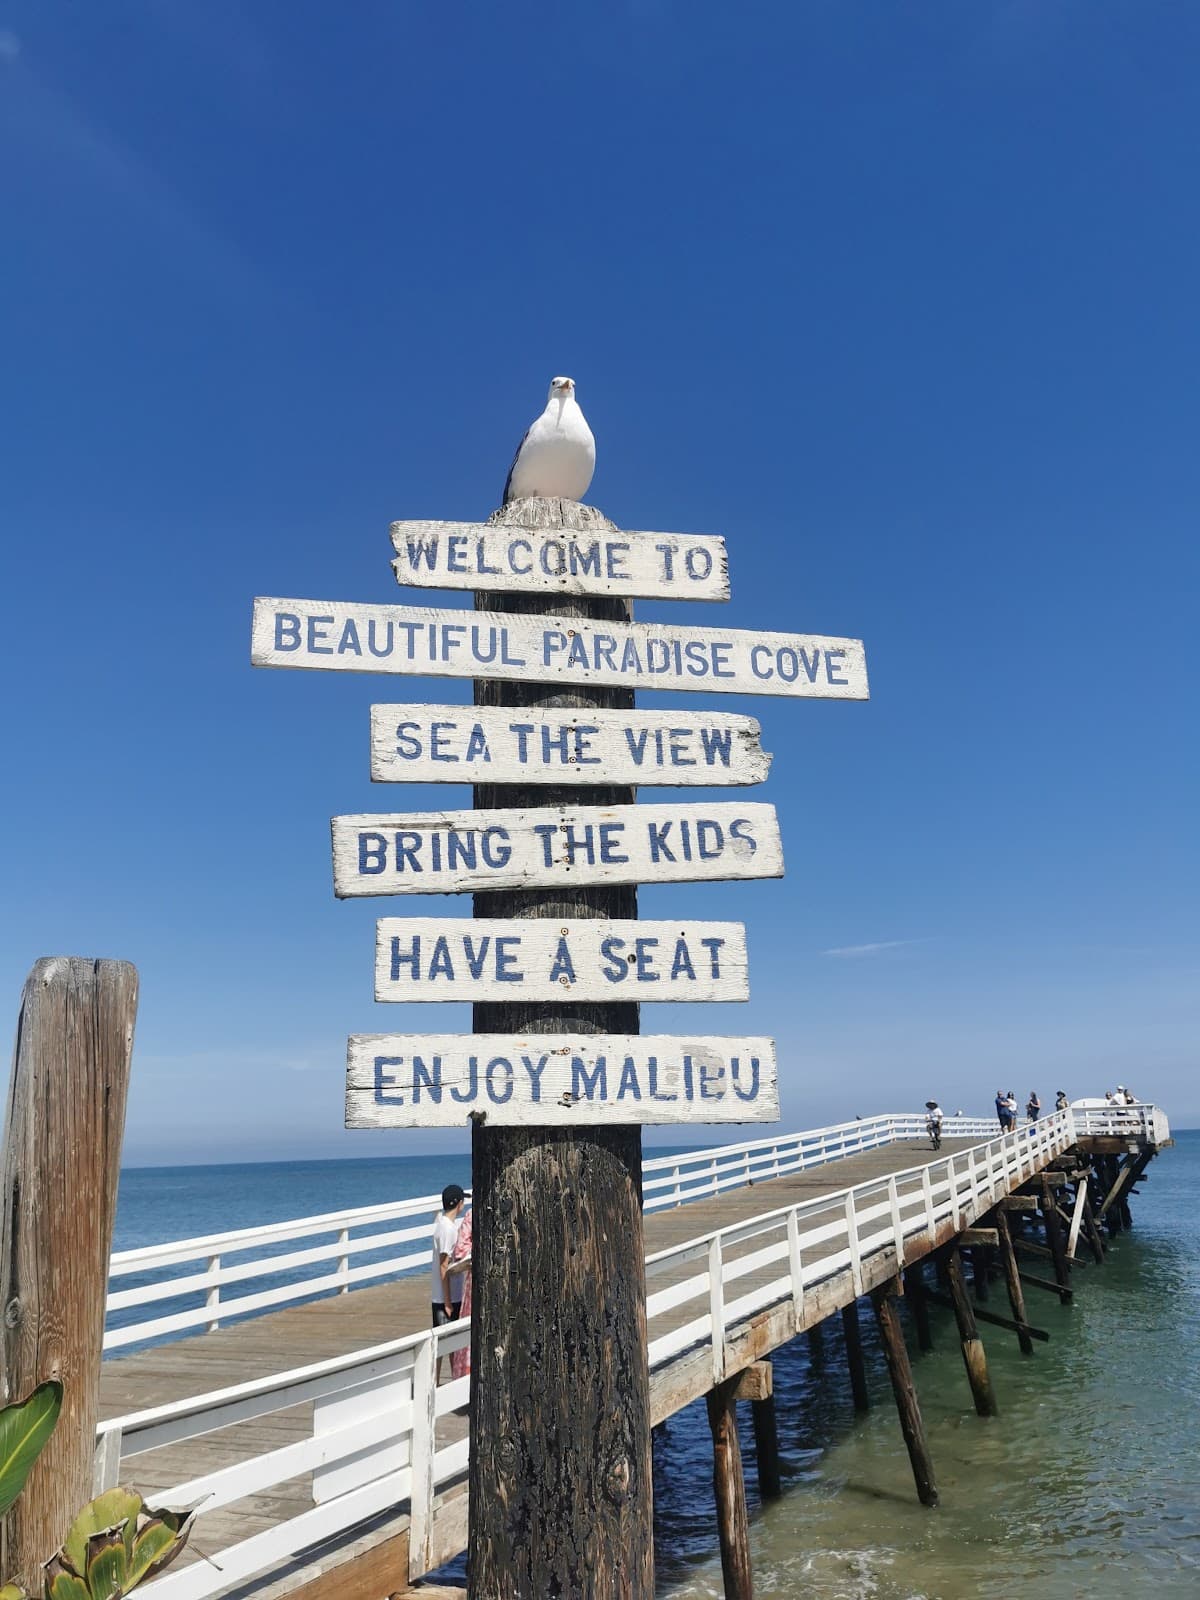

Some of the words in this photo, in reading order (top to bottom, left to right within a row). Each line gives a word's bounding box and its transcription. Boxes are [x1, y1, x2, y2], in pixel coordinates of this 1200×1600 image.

[405, 535, 631, 580] WELCOME
[656, 544, 713, 581] TO
[273, 613, 527, 667] BEAUTIFUL
[543, 631, 736, 679] PARADISE
[751, 646, 849, 686] COVE
[396, 722, 492, 763] SEA
[509, 724, 602, 765] THE
[624, 728, 733, 767] VIEW
[358, 826, 514, 875] BRING
[534, 823, 630, 868] THE
[648, 818, 758, 863] KIDS
[390, 935, 525, 982] HAVE
[549, 936, 578, 984] A
[600, 937, 726, 983] SEAT
[373, 1056, 551, 1106] ENJOY
[570, 1055, 761, 1102] MALIBU
